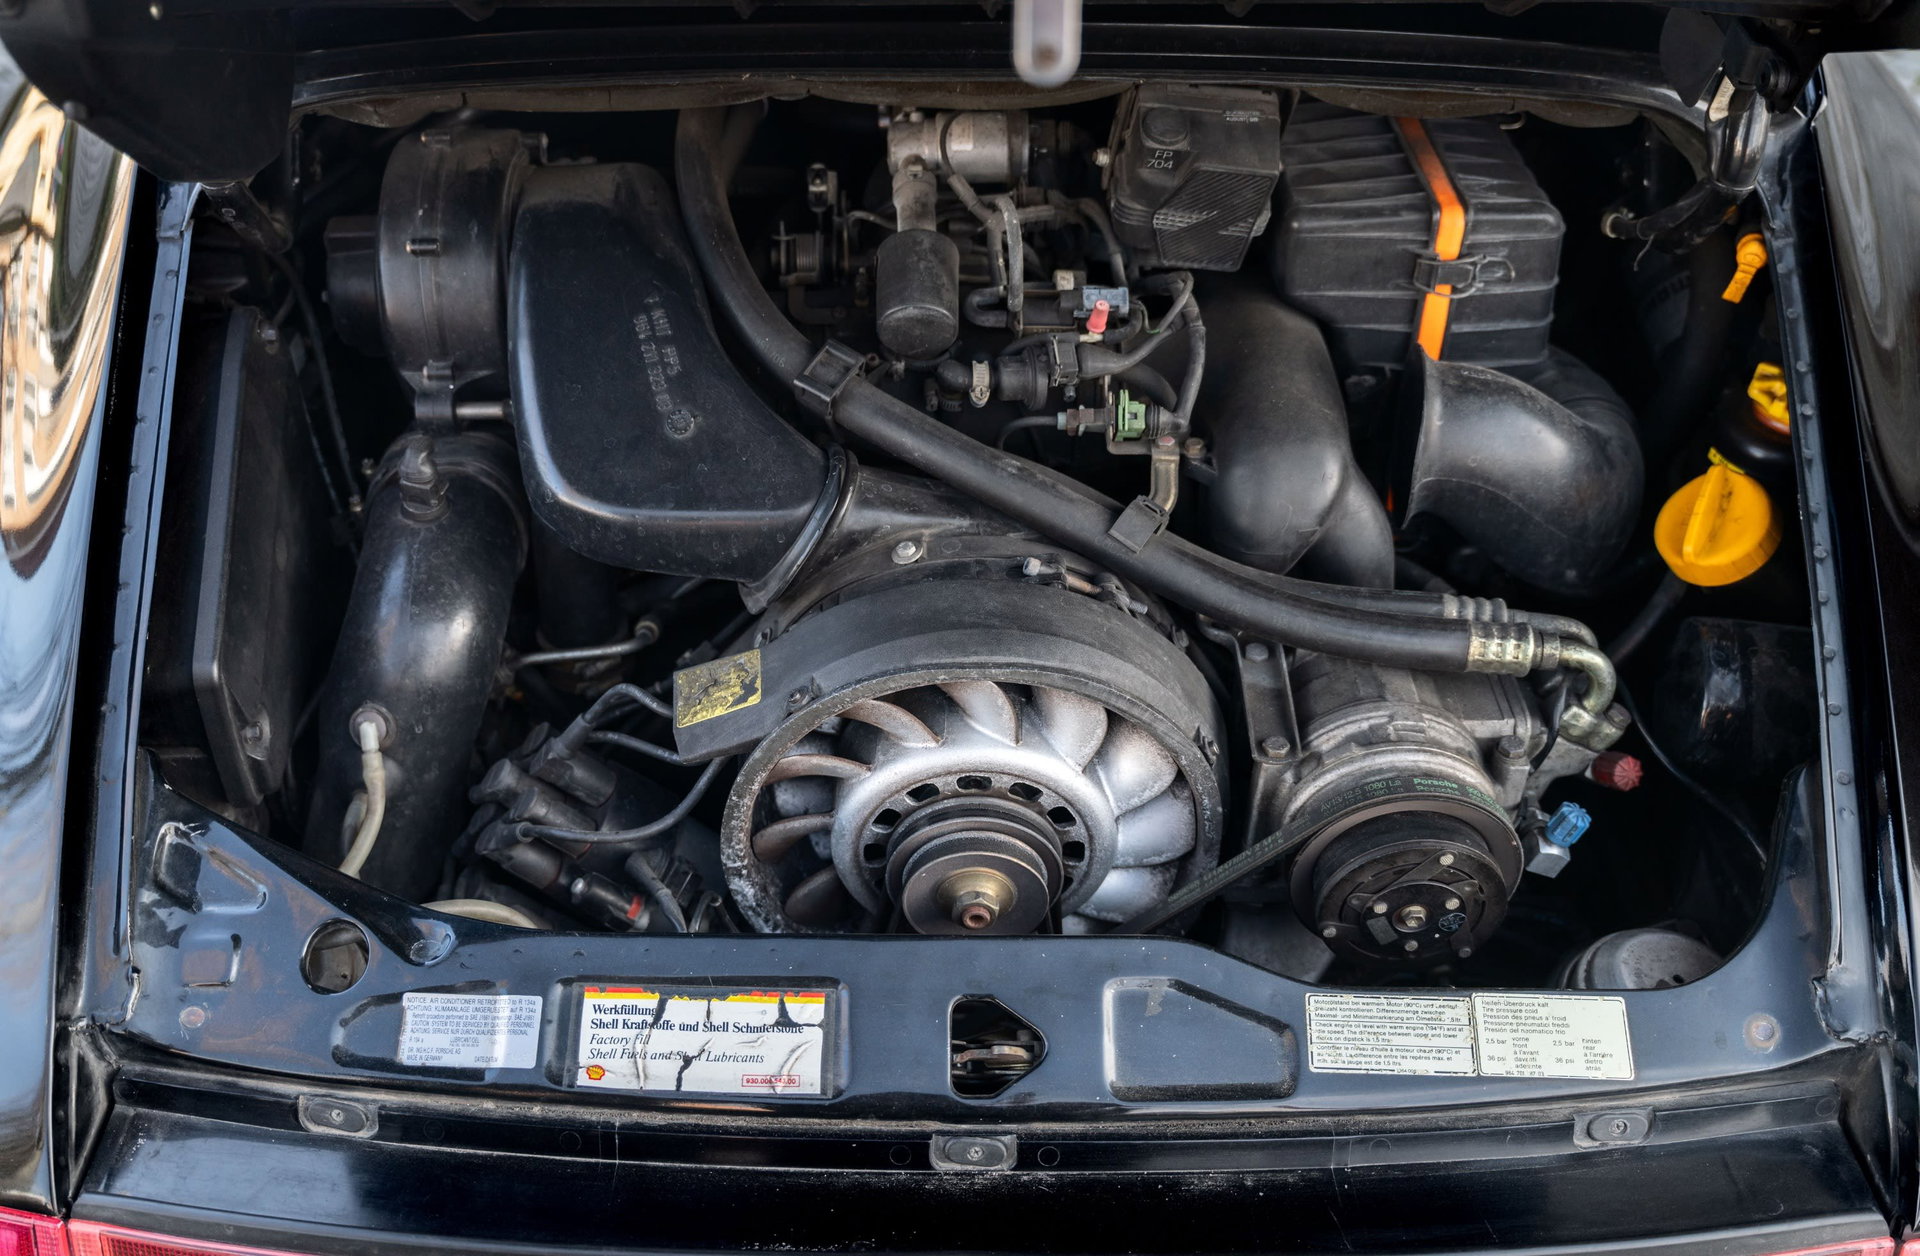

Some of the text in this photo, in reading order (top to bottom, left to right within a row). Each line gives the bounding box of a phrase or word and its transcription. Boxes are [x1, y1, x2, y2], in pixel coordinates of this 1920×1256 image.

[1154, 150, 1174, 159] FP
[1146, 160, 1174, 169] 704
[1413, 778, 1458, 789] Porsche
[592, 1004, 656, 1017] Werkfüllung
[590, 1018, 618, 1029] Shell
[622, 1019, 675, 1030] Kraftsoffe
[679, 1021, 699, 1032] und
[702, 1021, 729, 1032] Shell
[590, 1034, 631, 1047] Factory
[588, 1048, 617, 1060] Shell
[620, 1049, 647, 1060] Fuels
[650, 1051, 673, 1060] and
[706, 1051, 764, 1063] Lubricants
